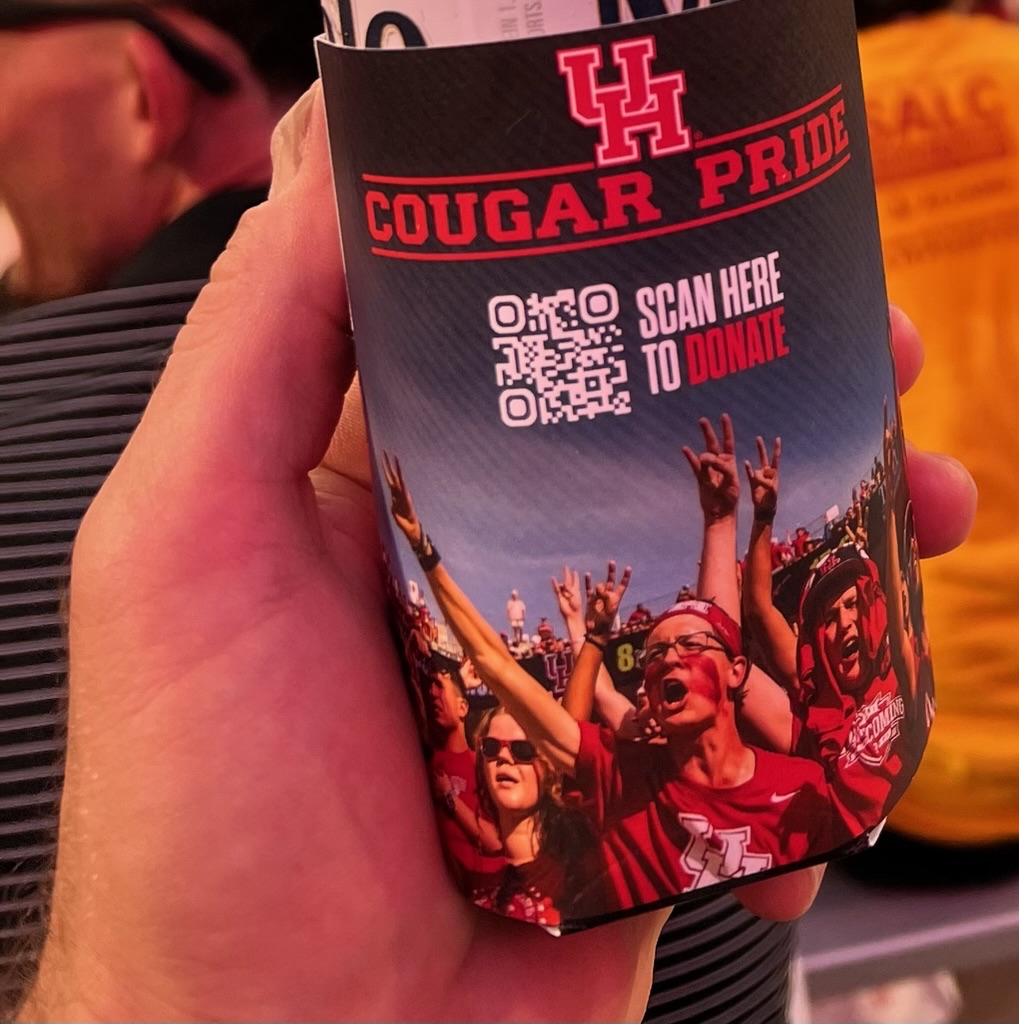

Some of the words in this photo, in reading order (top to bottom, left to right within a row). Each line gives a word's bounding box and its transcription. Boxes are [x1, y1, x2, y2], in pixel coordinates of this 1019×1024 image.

[556, 35, 691, 167] UH
[365, 170, 661, 246] COUGAR
[695, 98, 850, 210] PRIDE
[636, 273, 716, 339] SCAN
[719, 251, 785, 318] HERE
[642, 340, 682, 395] TO
[685, 307, 790, 386] DONATE
